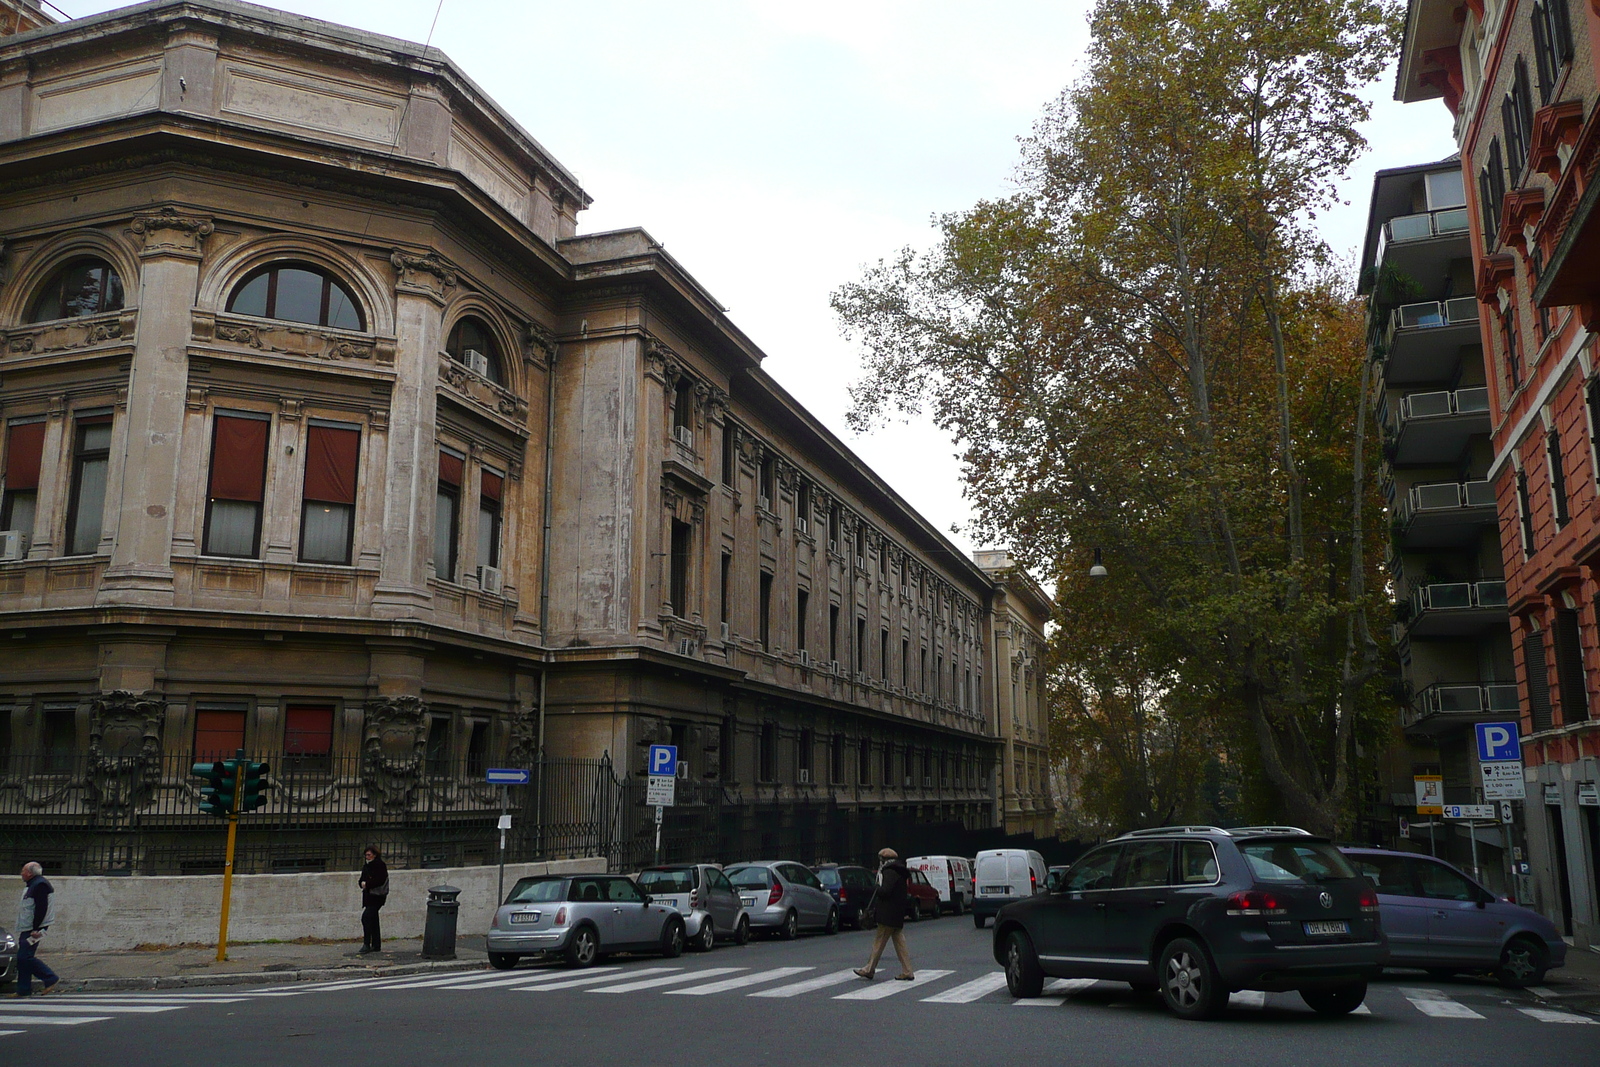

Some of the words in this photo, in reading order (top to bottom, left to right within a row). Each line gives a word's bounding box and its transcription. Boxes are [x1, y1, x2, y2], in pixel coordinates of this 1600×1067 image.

[1484, 727, 1510, 757] P
[654, 748, 671, 772] P
[1453, 807, 1459, 816] P
[1521, 863, 1529, 872] P
